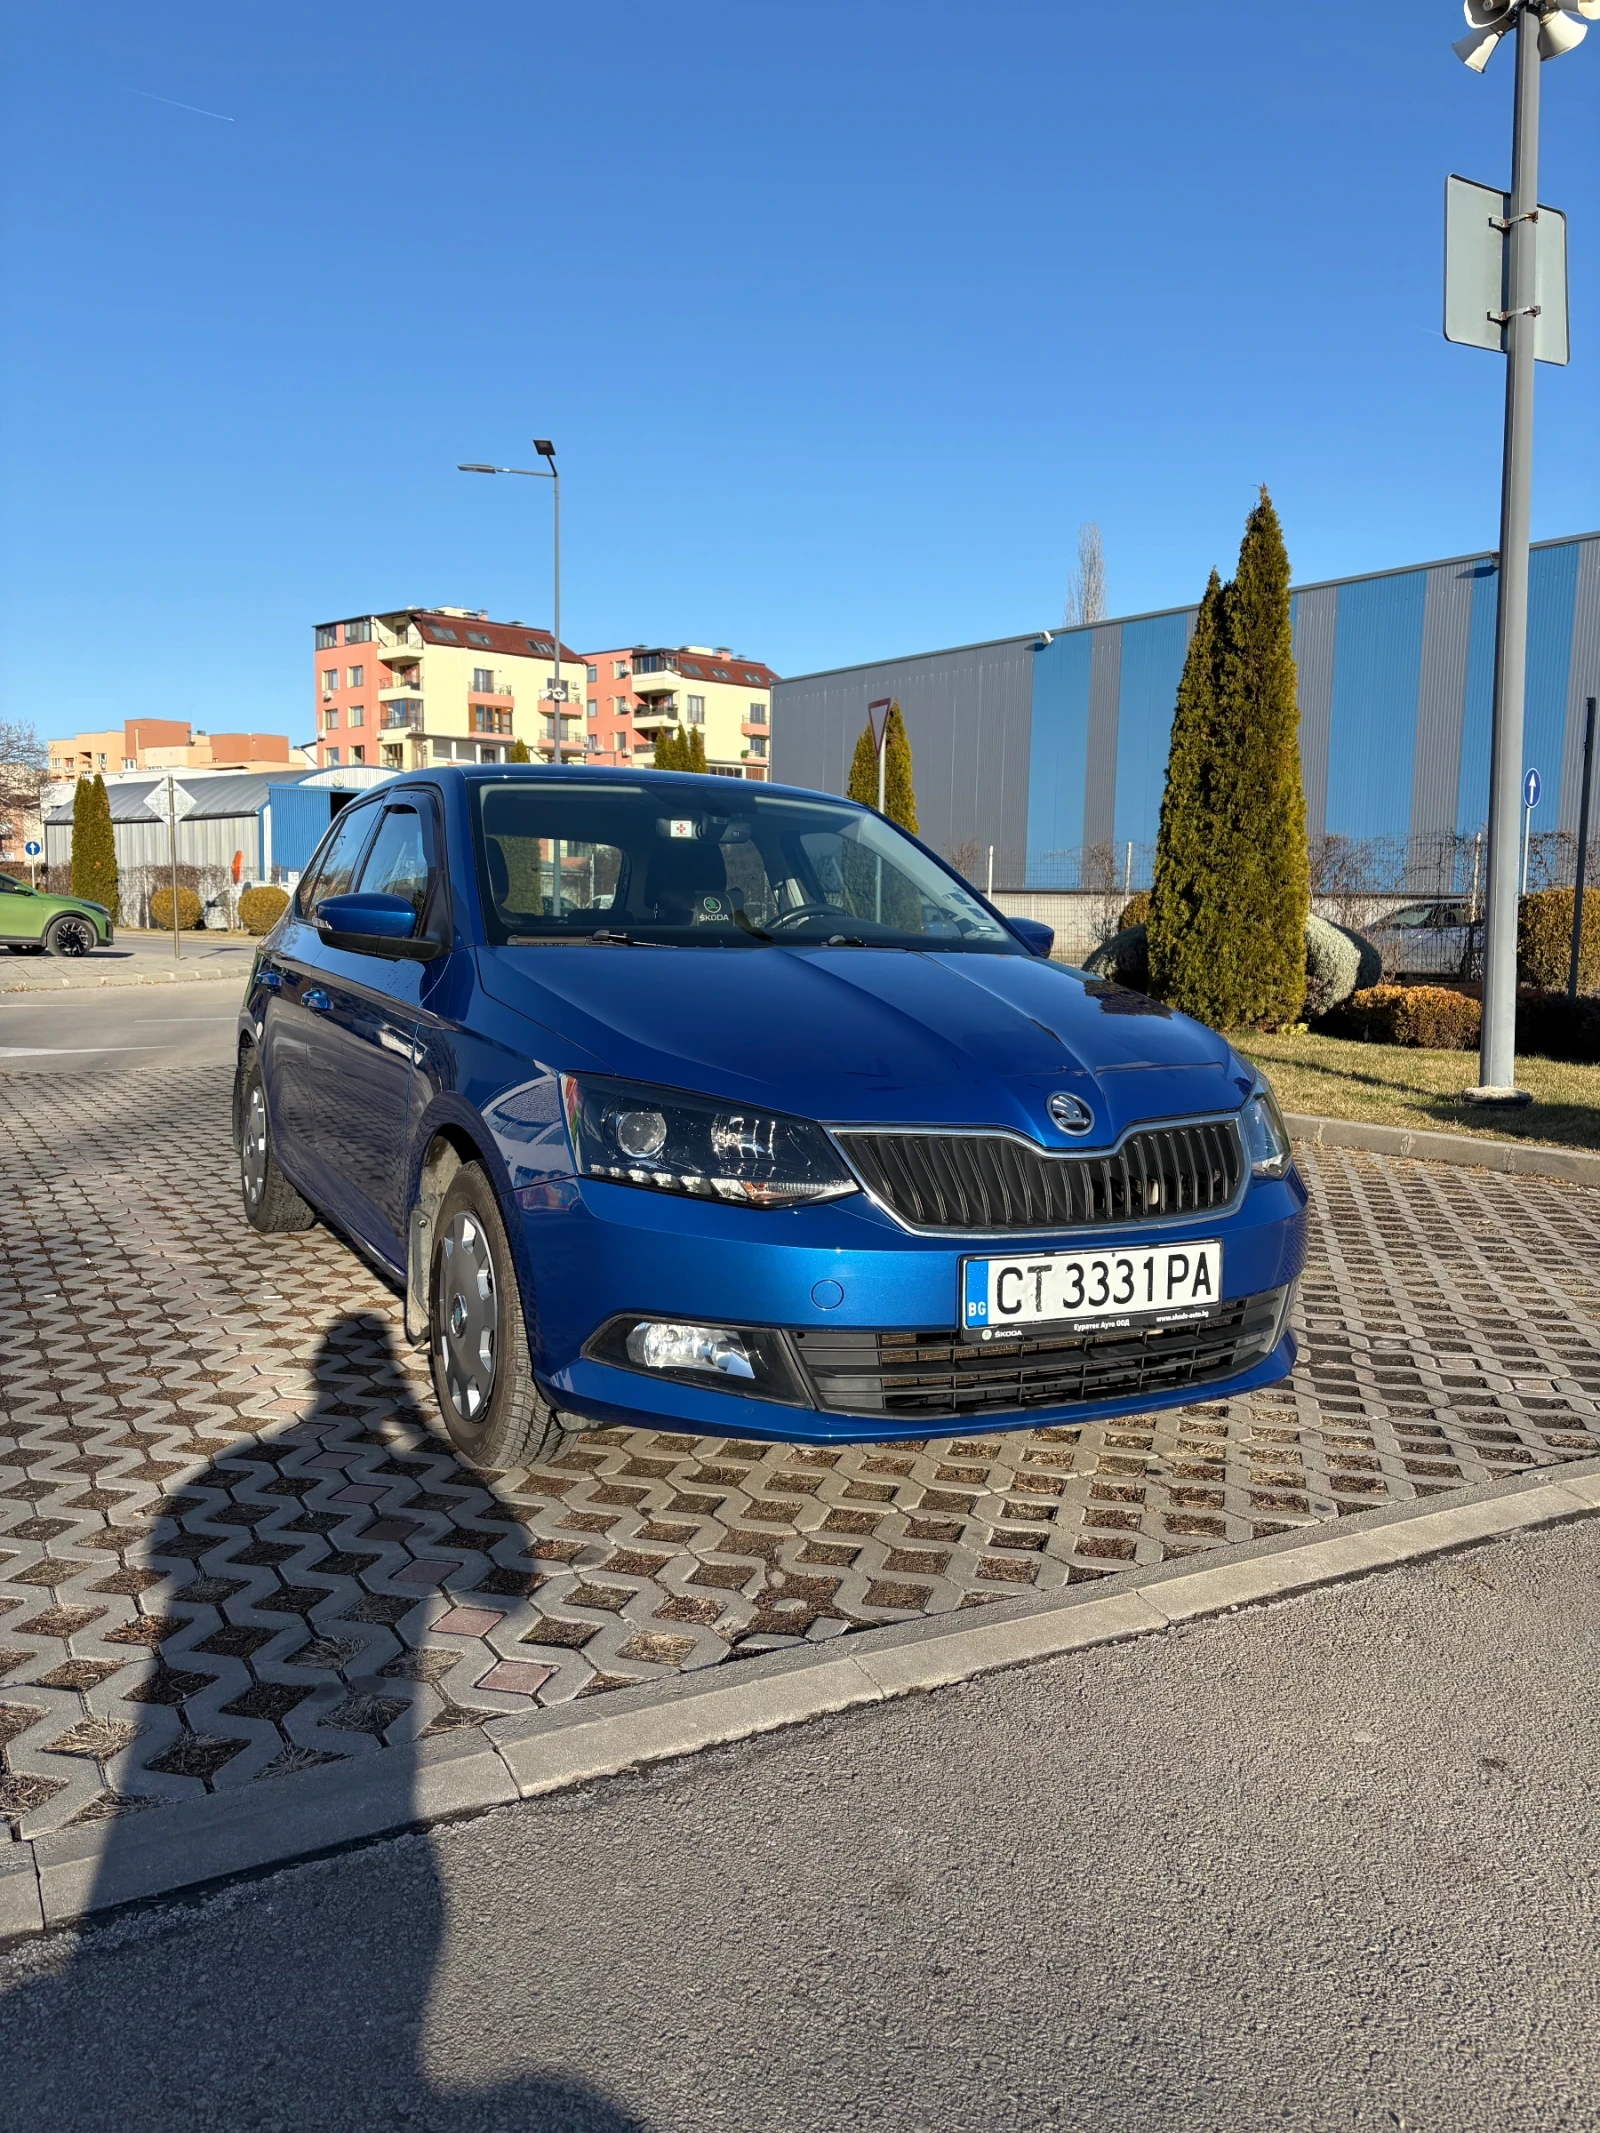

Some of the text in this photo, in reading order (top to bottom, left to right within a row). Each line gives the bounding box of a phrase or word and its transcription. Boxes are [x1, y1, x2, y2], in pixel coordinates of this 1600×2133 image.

[699, 913, 729, 921] ŠKODA
[997, 1252, 1212, 1314] CT 3331 PA
[968, 1301, 986, 1316] BG
[994, 1330, 1022, 1338] ŠKODA
